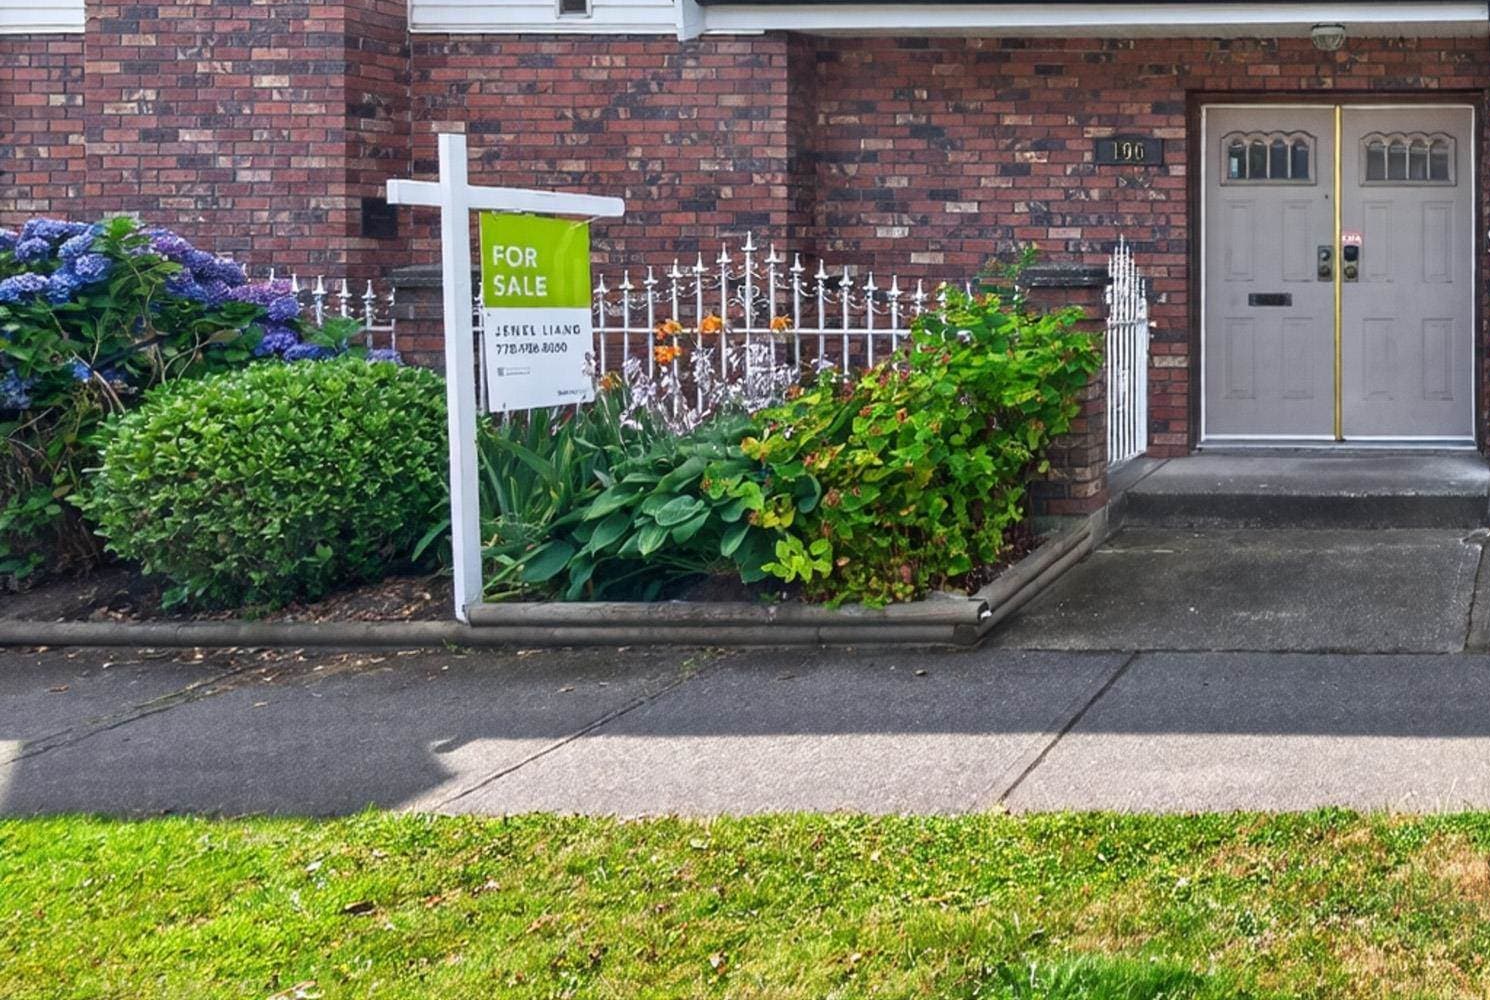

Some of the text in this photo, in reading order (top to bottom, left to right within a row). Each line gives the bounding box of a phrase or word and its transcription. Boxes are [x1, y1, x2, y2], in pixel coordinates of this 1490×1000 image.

[492, 245, 538, 268] FOR
[493, 274, 548, 296] SALE
[542, 324, 581, 335] LIANG
